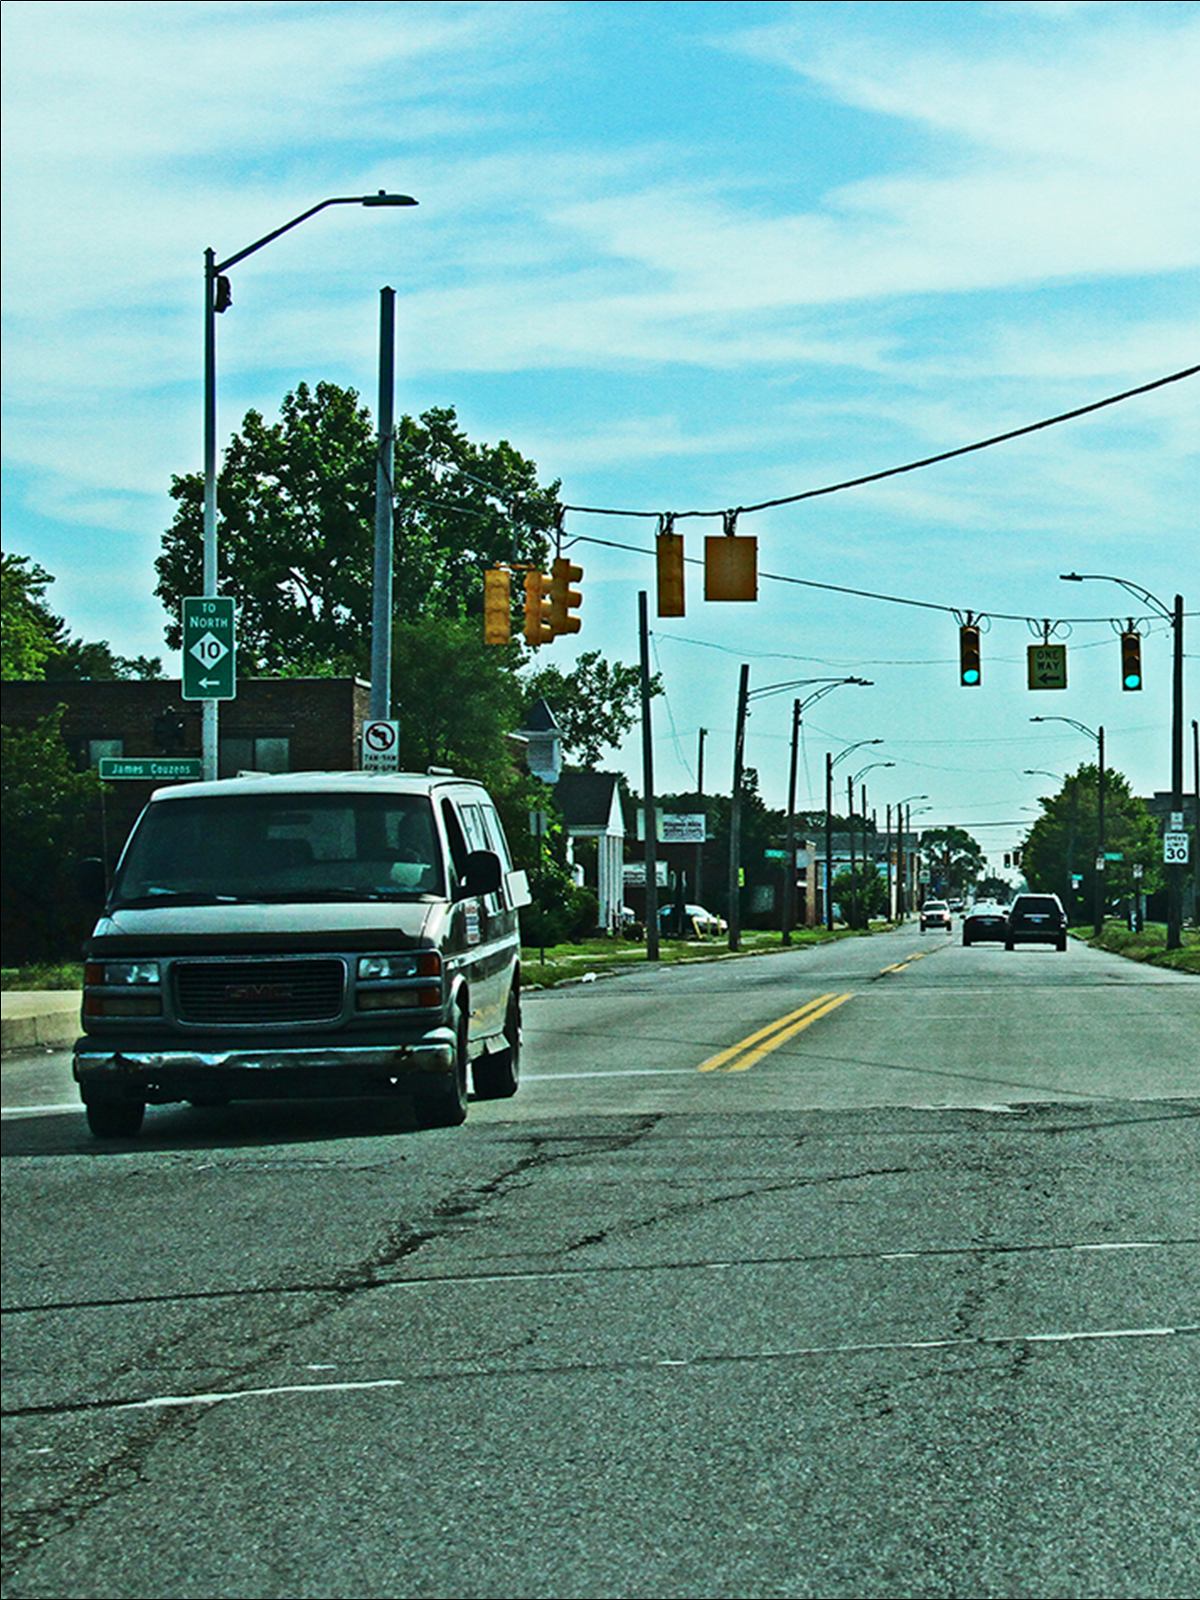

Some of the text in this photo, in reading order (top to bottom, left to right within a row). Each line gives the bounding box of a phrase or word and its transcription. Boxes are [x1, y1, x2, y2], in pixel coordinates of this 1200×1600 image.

[202, 603, 217, 614] TO
[189, 615, 228, 629] NORTH
[200, 641, 221, 659] 10
[1037, 649, 1060, 660] ONE
[1037, 661, 1060, 671] WAY
[111, 763, 191, 775] James Couzens
[1166, 847, 1187, 860] 30
[225, 984, 293, 1000] GMC
